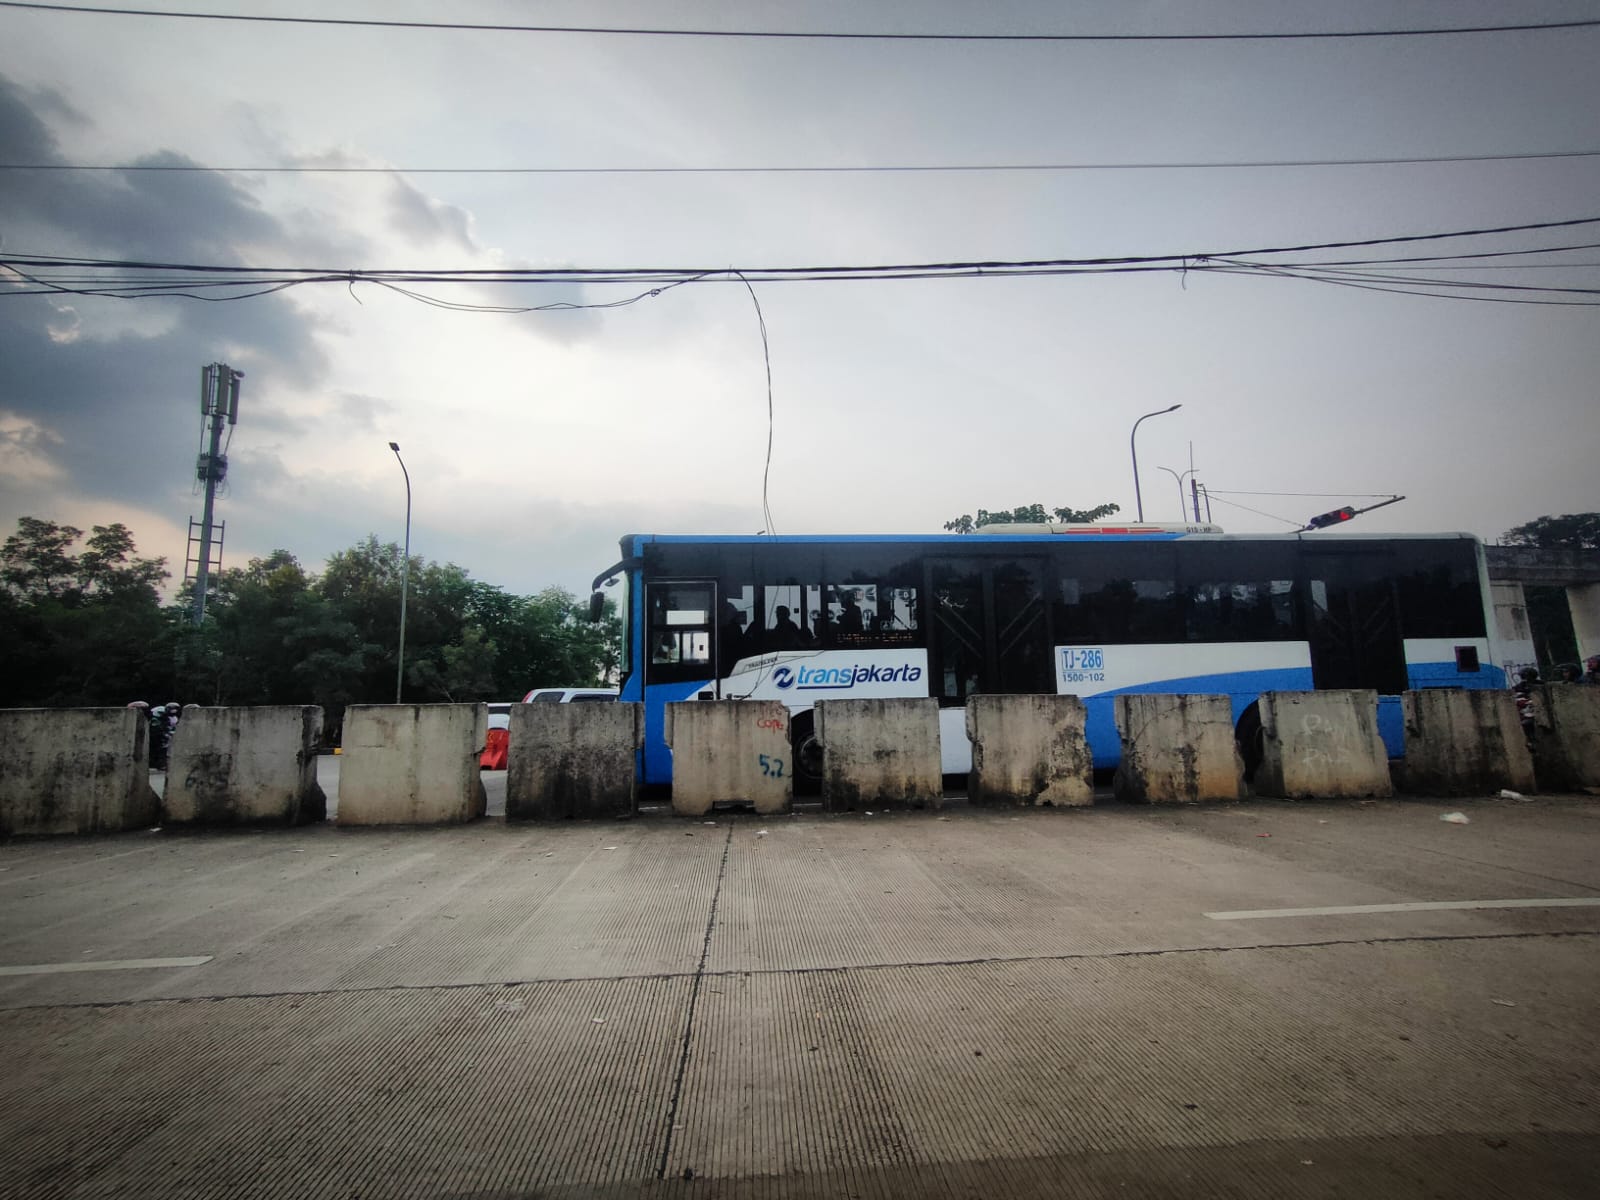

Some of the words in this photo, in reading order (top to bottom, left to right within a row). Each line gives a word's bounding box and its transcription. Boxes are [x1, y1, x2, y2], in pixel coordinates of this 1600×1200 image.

[1062, 649, 1102, 669] TJ-286
[797, 664, 922, 689] transjakarta
[1063, 672, 1105, 682] 1500-102
